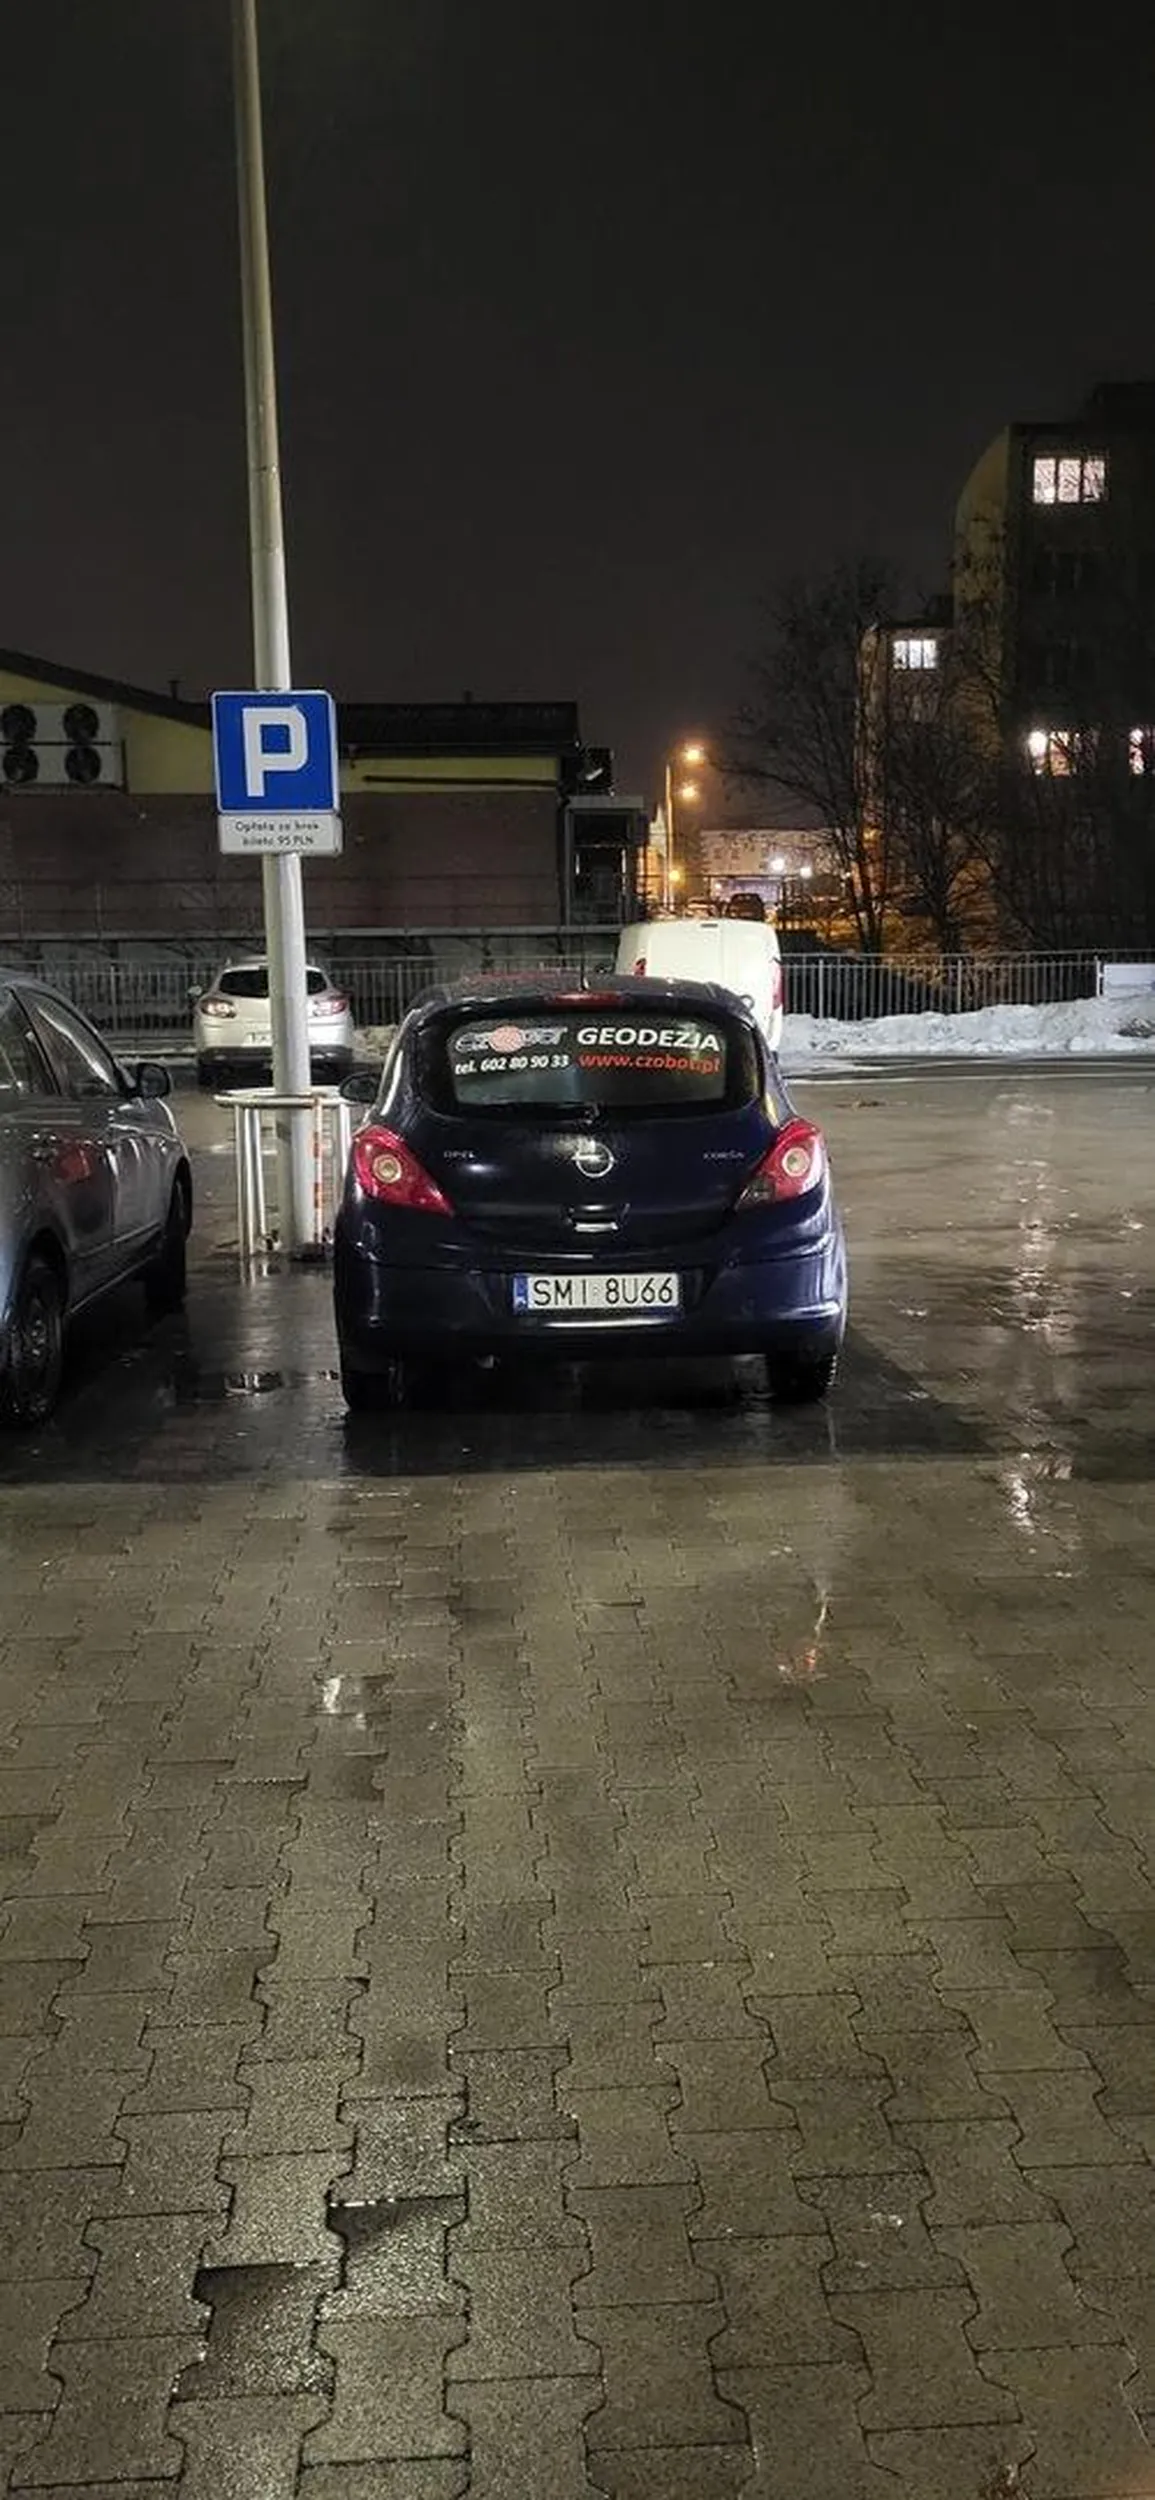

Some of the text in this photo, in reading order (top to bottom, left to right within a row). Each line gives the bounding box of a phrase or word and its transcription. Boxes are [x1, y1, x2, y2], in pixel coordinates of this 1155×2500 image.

[242, 705, 309, 798] P
[576, 1026, 720, 1052] GEODEZJA
[480, 1056, 507, 1072] 602
[508, 1055, 529, 1070] 80
[529, 1054, 550, 1069] 90
[550, 1053, 570, 1068] 33
[579, 1053, 720, 1074] www.czobot.pl
[533, 1278, 588, 1306] SMI
[605, 1277, 674, 1304] 8U66
